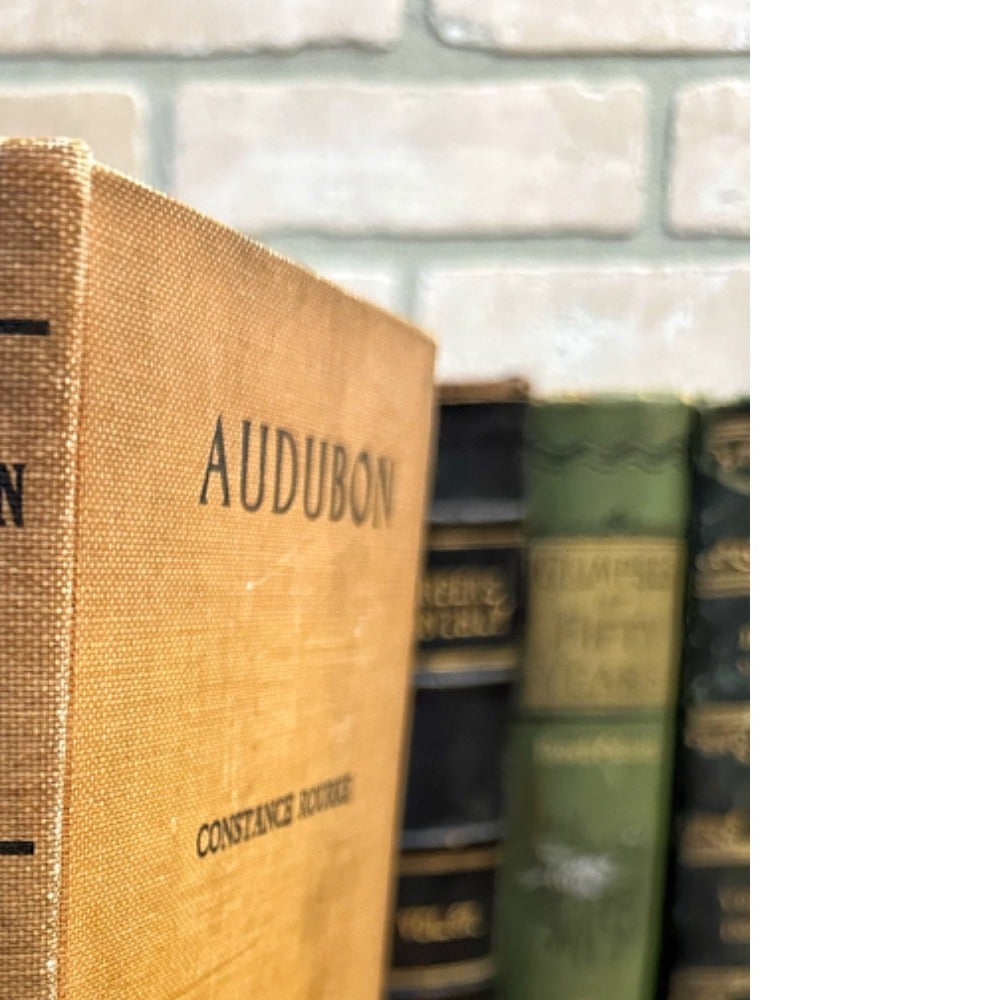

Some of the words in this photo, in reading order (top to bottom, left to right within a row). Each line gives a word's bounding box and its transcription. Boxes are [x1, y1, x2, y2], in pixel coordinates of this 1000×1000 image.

[199, 414, 394, 529] AUDUBON
[196, 791, 294, 858] CONSTANCE
[297, 770, 354, 820] ROURKE
